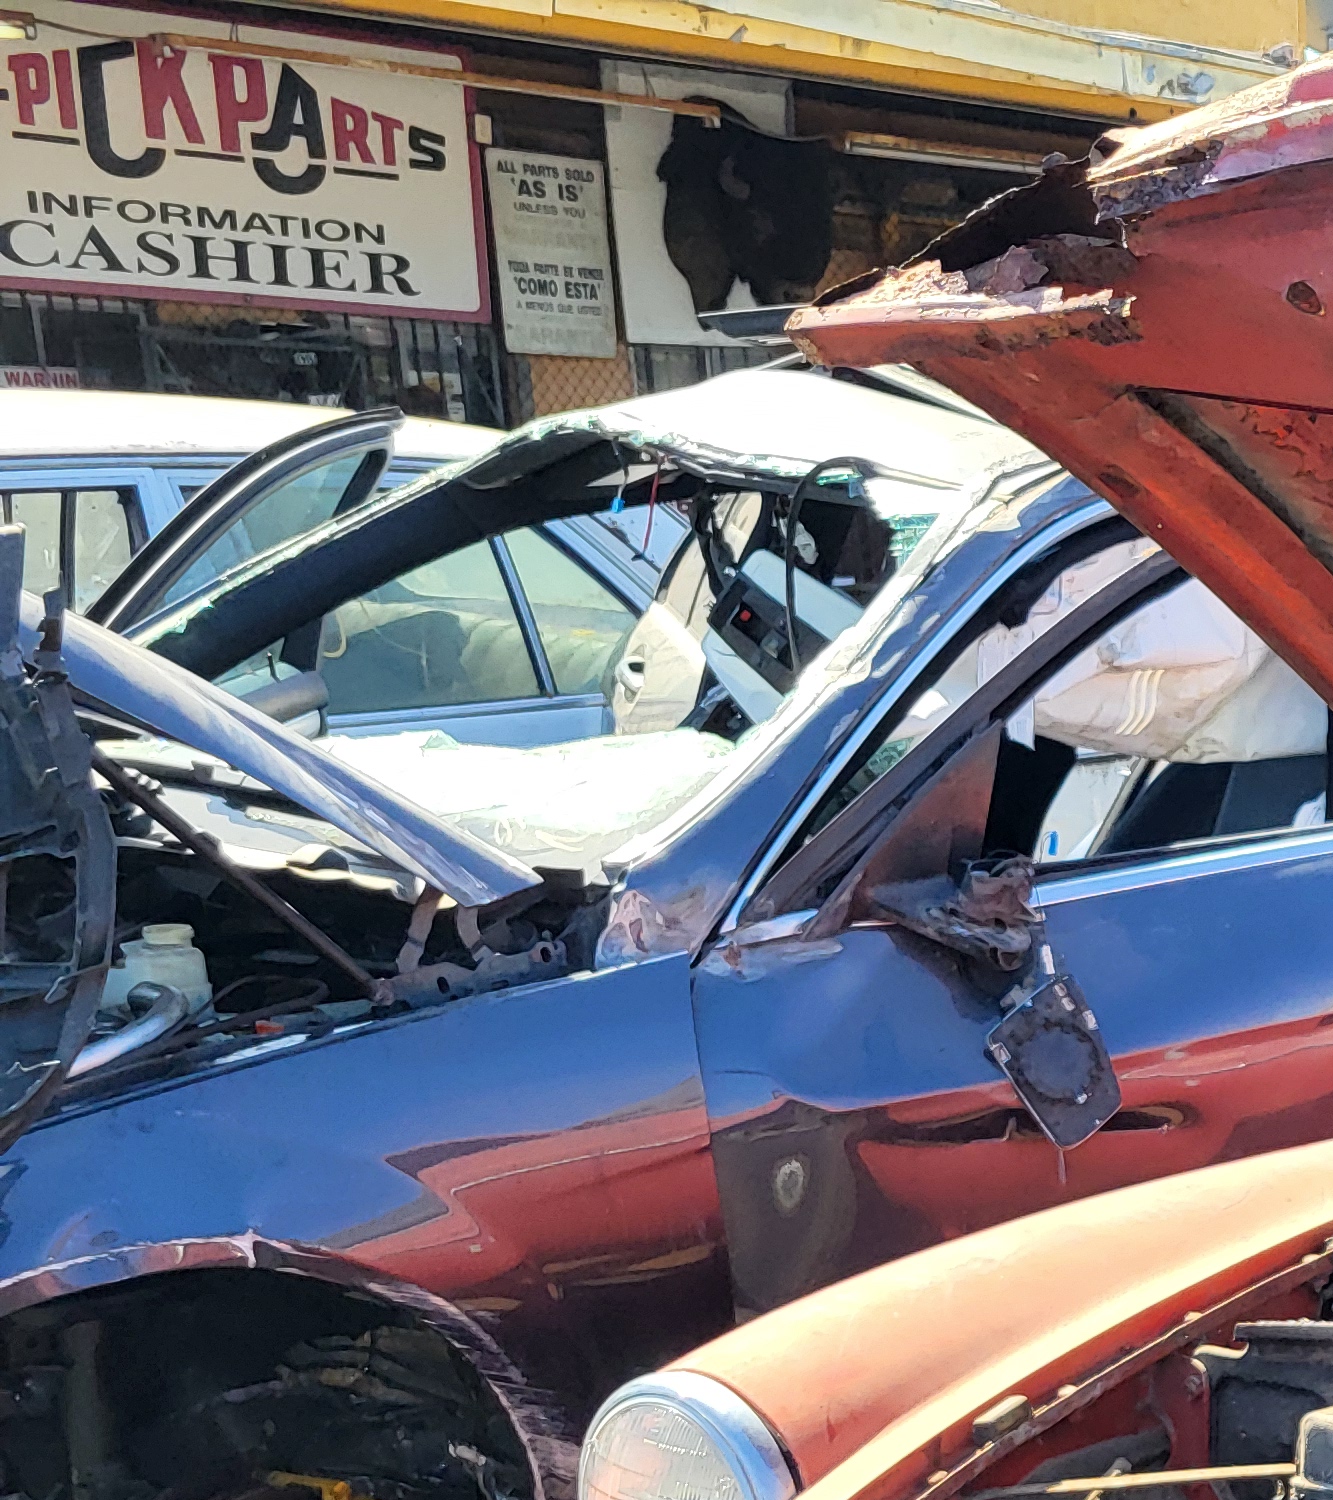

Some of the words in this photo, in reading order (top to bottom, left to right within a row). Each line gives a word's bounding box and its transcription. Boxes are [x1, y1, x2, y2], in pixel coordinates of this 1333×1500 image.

[497, 160, 518, 174] ALL
[523, 163, 559, 179] PARTS
[564, 167, 595, 182] SOLD
[26, 190, 386, 245] INFORMATION
[513, 201, 559, 215] UNLESS
[562, 206, 586, 219] YOU
[0, 219, 422, 297] CASHIER
[4, 371, 78, 388] WARNIN
